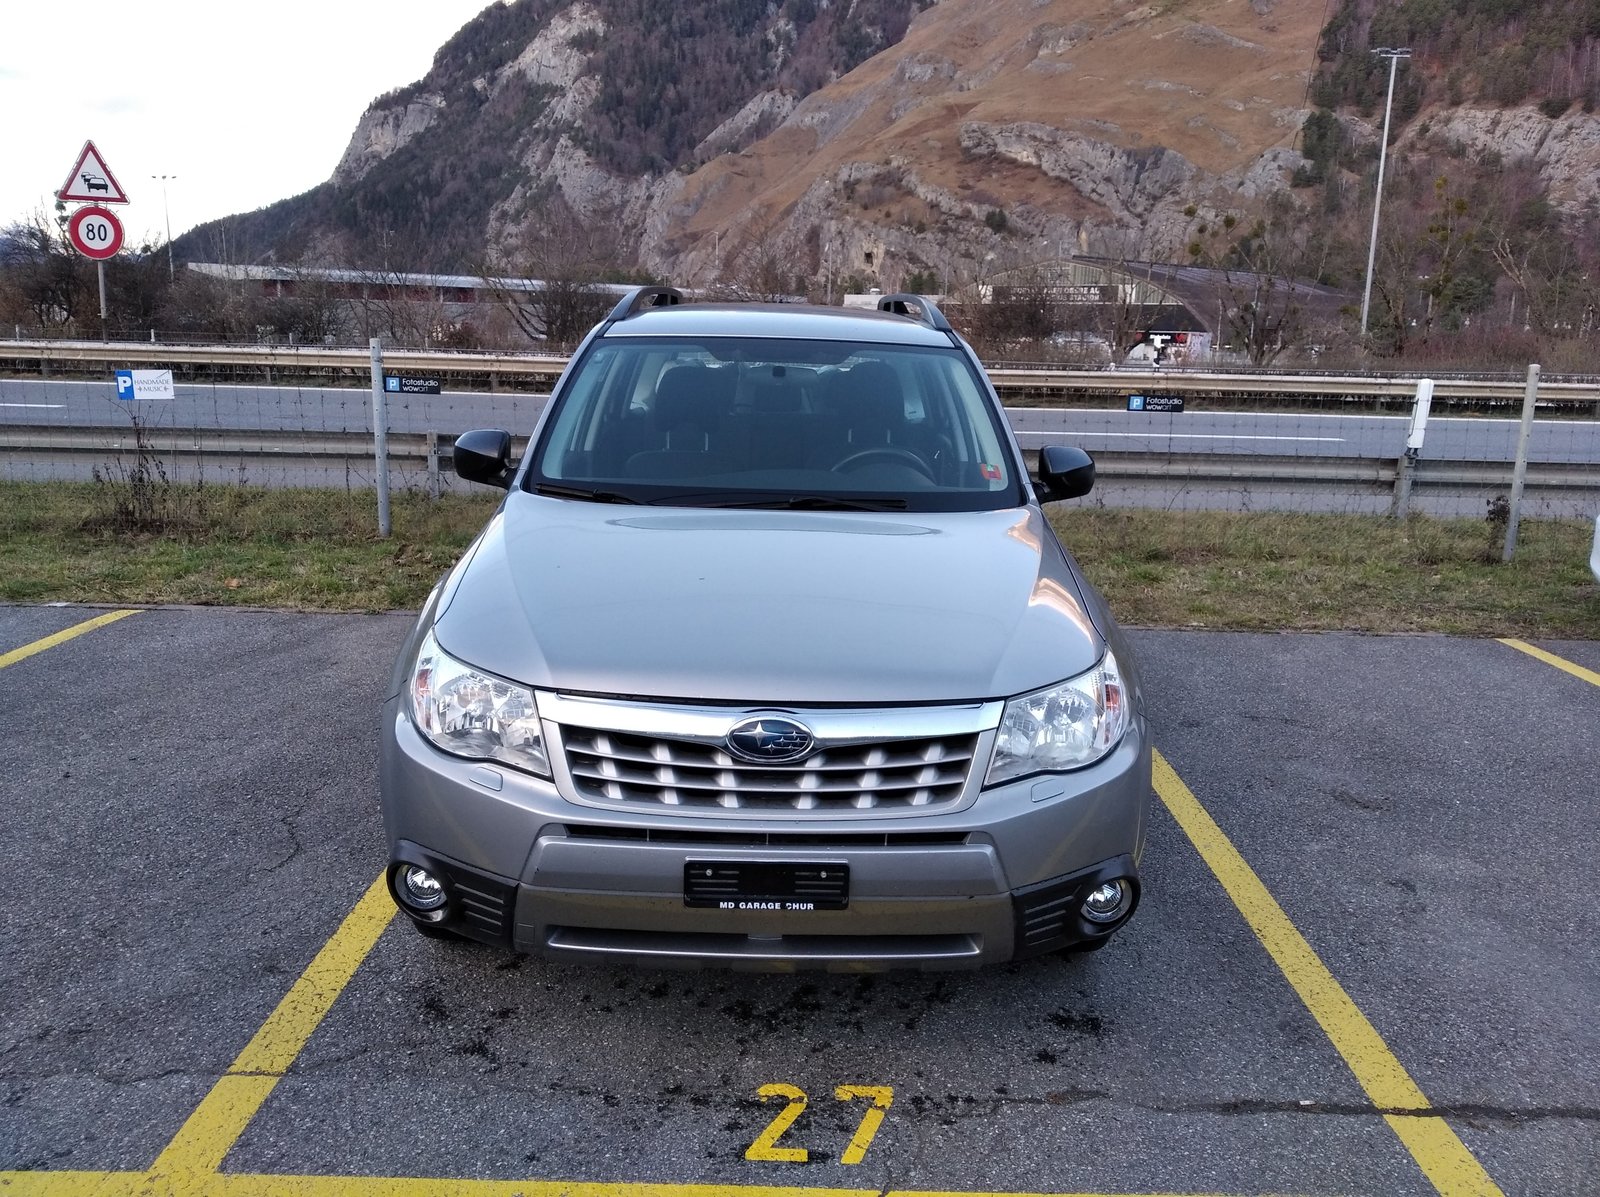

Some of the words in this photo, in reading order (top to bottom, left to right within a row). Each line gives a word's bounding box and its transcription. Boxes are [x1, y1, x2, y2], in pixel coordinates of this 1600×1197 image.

[86, 223, 107, 241] 80
[117, 376, 132, 393] P
[389, 379, 397, 389] P
[402, 378, 439, 387] Fotostudio
[1133, 398, 1141, 409] P
[1146, 396, 1183, 405] Fotostudio
[719, 901, 735, 909] MD
[739, 902, 781, 910] GARAGE
[744, 1082, 895, 1165] 27
